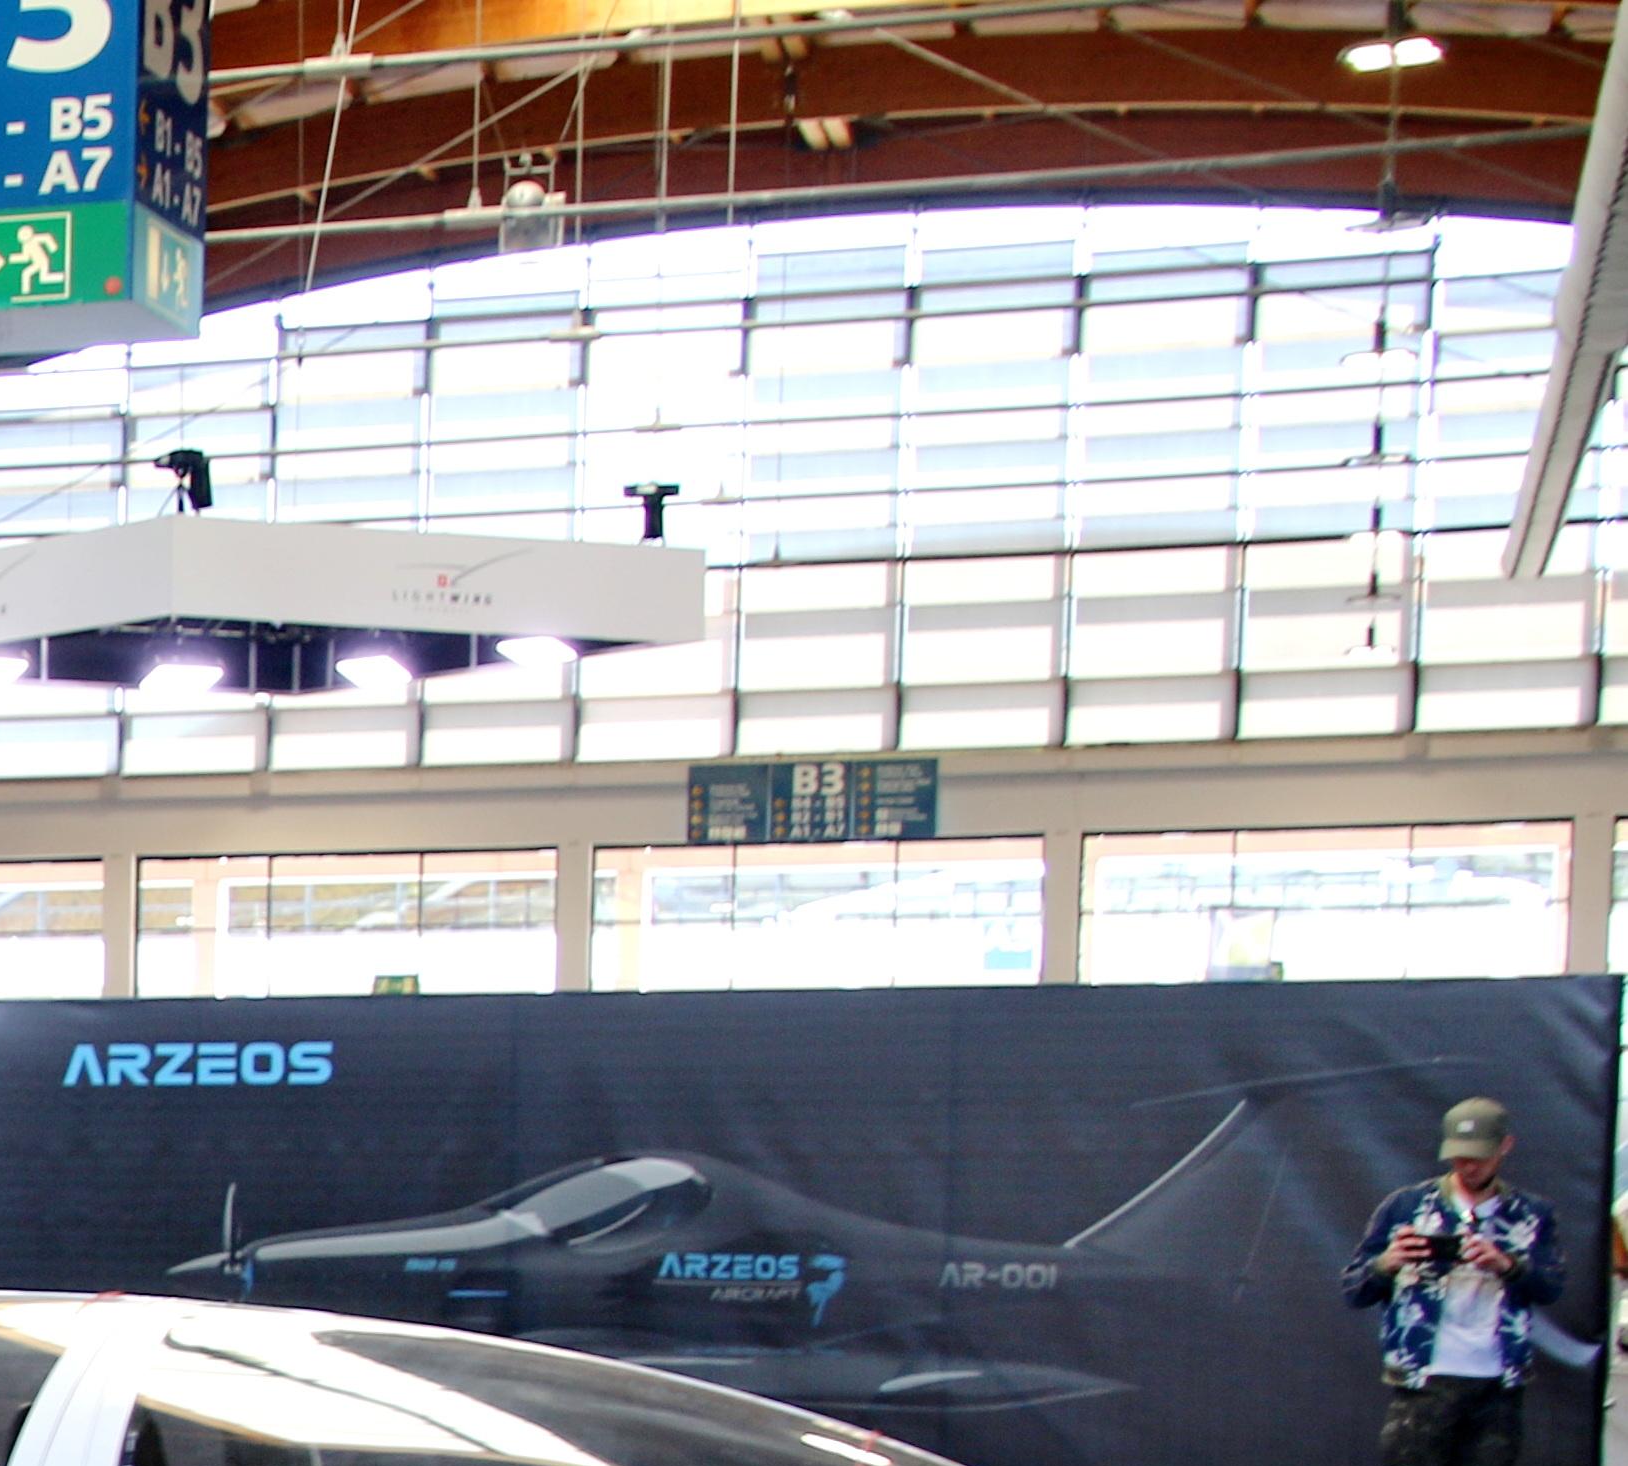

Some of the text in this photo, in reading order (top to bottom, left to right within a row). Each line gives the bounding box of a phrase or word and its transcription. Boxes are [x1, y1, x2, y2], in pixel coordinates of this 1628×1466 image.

[6, 121, 25, 134] -
[49, 94, 113, 142] B5
[154, 108, 172, 158] B1
[185, 129, 202, 180] B5
[4, 174, 24, 187] -
[39, 146, 113, 194] A7
[152, 163, 171, 210] A1
[181, 182, 202, 228] A7
[794, 763, 845, 796] B3
[62, 1041, 334, 1087] ARZEOS
[658, 1252, 800, 1280] ARZEOS
[939, 1261, 1058, 1289] AR-001
